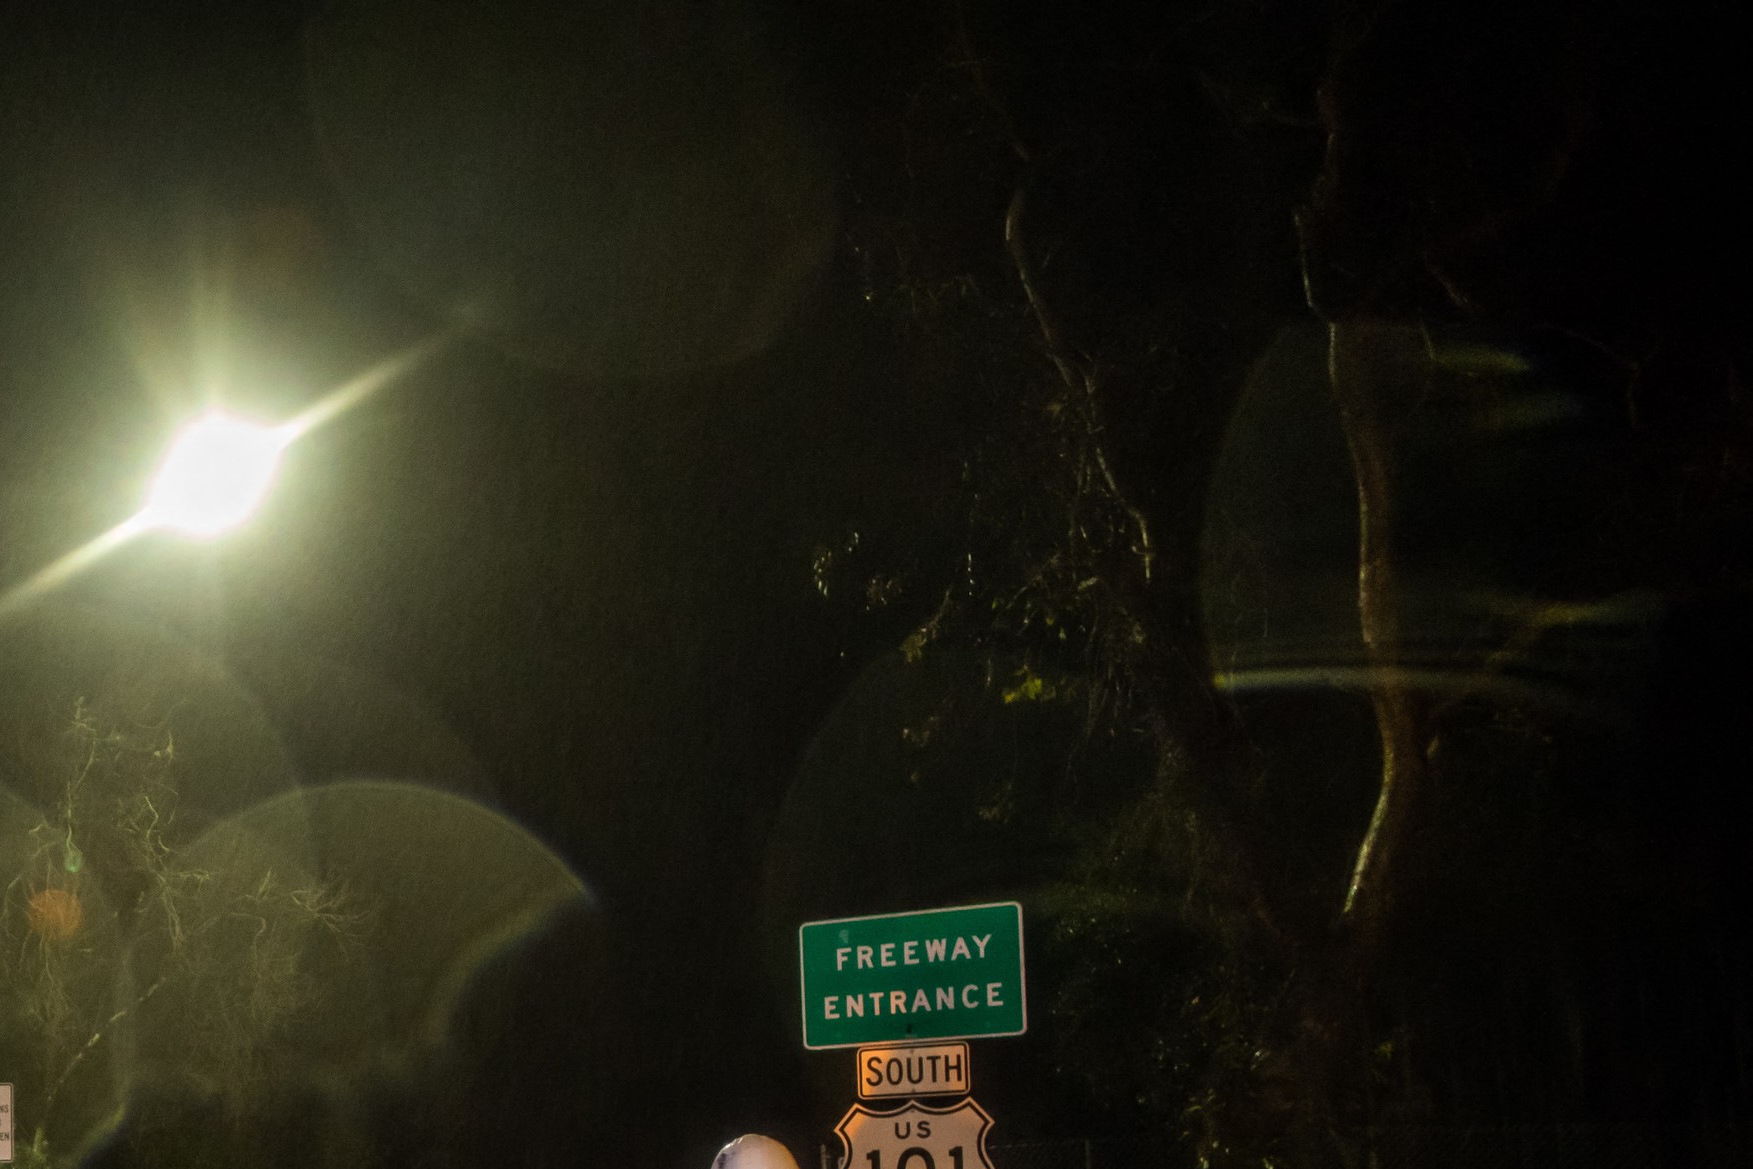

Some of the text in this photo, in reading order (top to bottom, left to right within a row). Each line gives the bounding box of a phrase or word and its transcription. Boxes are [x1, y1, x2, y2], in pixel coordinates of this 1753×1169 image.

[836, 934, 992, 971] FREEWAY
[824, 982, 1004, 1020] ENTRANCE
[865, 1053, 963, 1087] SOUTH
[894, 1120, 932, 1140] US
